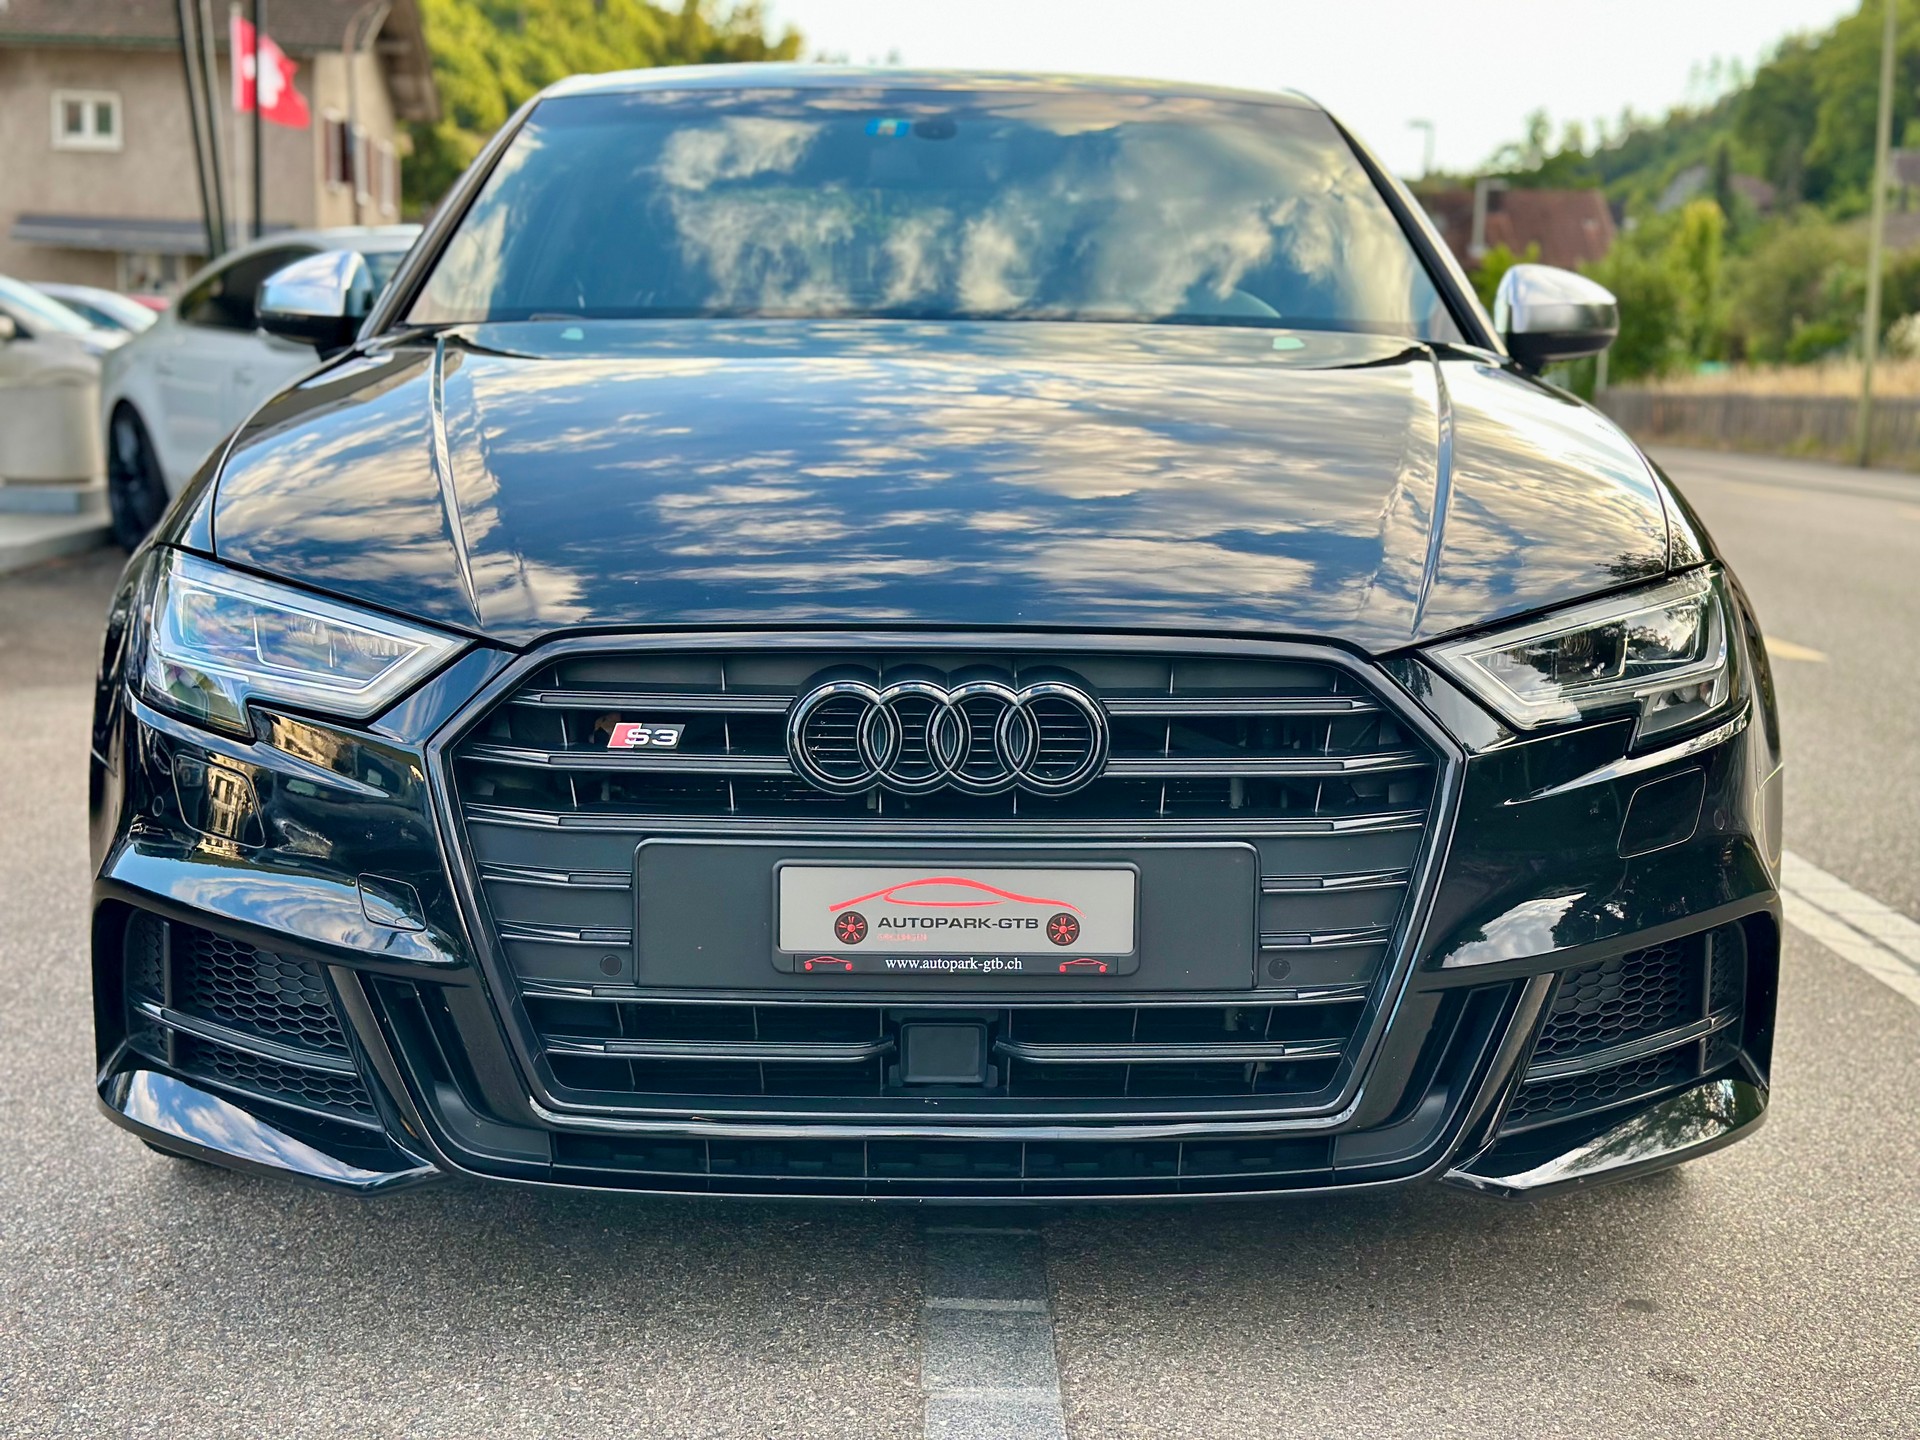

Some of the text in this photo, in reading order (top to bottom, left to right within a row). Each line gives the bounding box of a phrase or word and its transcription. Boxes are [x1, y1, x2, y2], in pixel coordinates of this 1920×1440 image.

[624, 728, 679, 746] S3
[877, 917, 1039, 929] AUTOPARK-GTB
[885, 957, 1023, 973] www.autopark-gtb.ch
